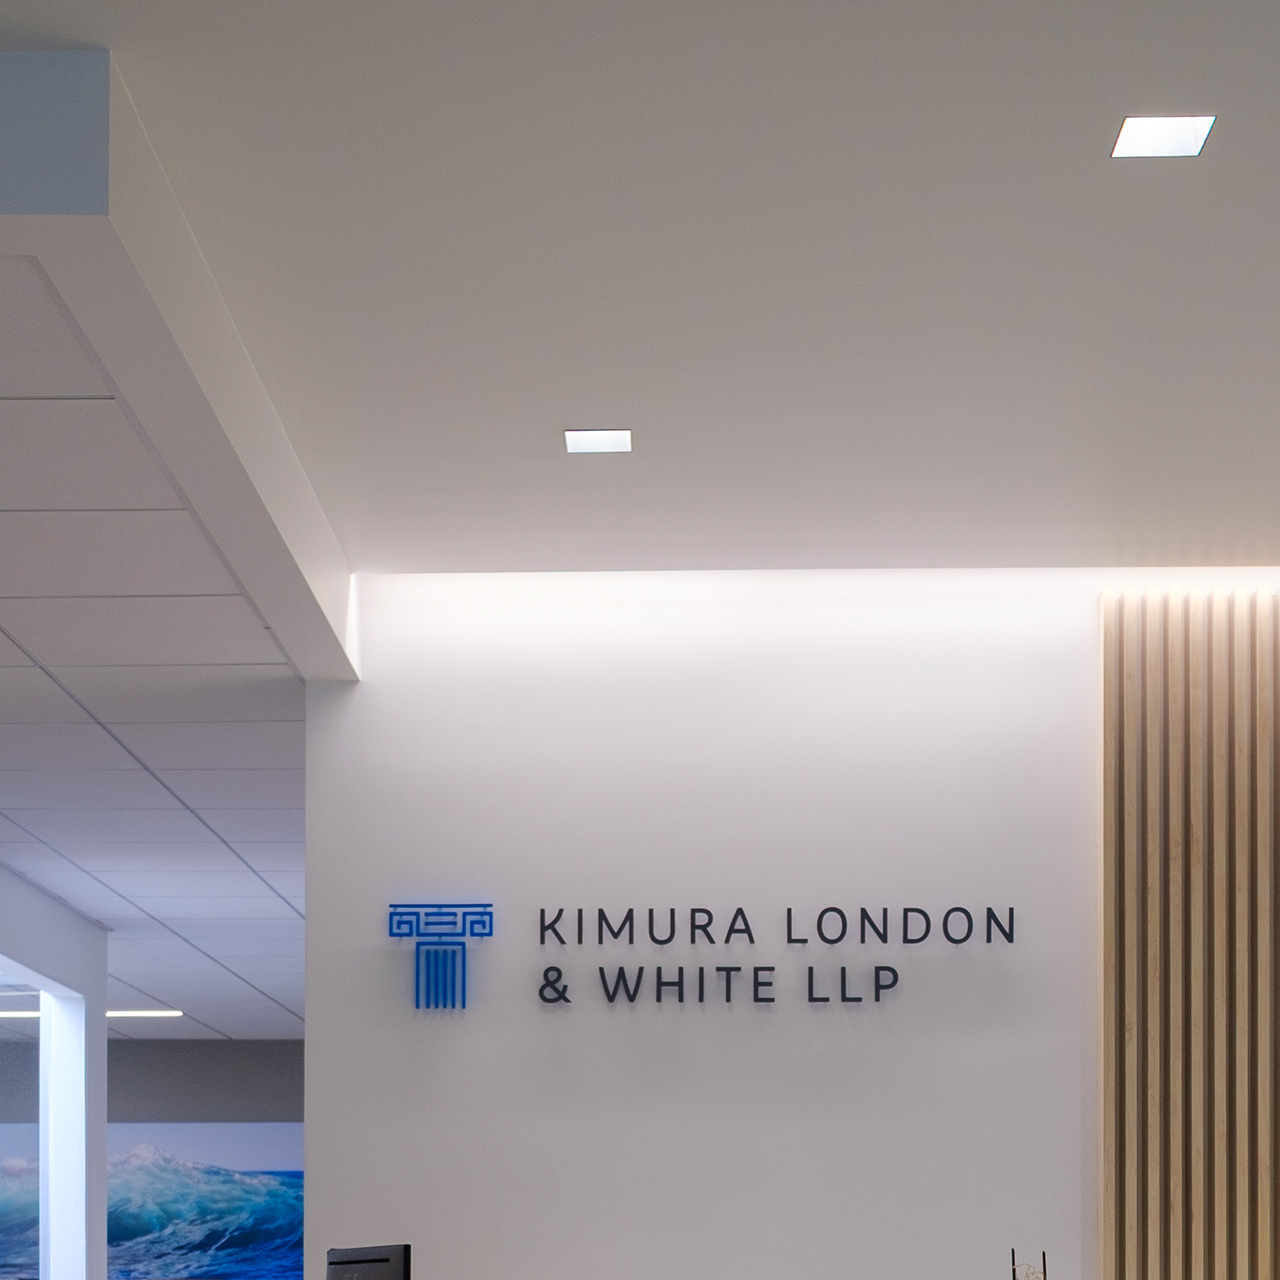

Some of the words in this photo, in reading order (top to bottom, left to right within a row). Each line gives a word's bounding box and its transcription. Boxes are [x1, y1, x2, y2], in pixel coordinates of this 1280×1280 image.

[539, 907, 755, 946] KIMURA
[786, 907, 1015, 946] LONDON
[538, 966, 571, 1003] &
[598, 966, 776, 1003] WHITE
[808, 966, 899, 1003] LLP
